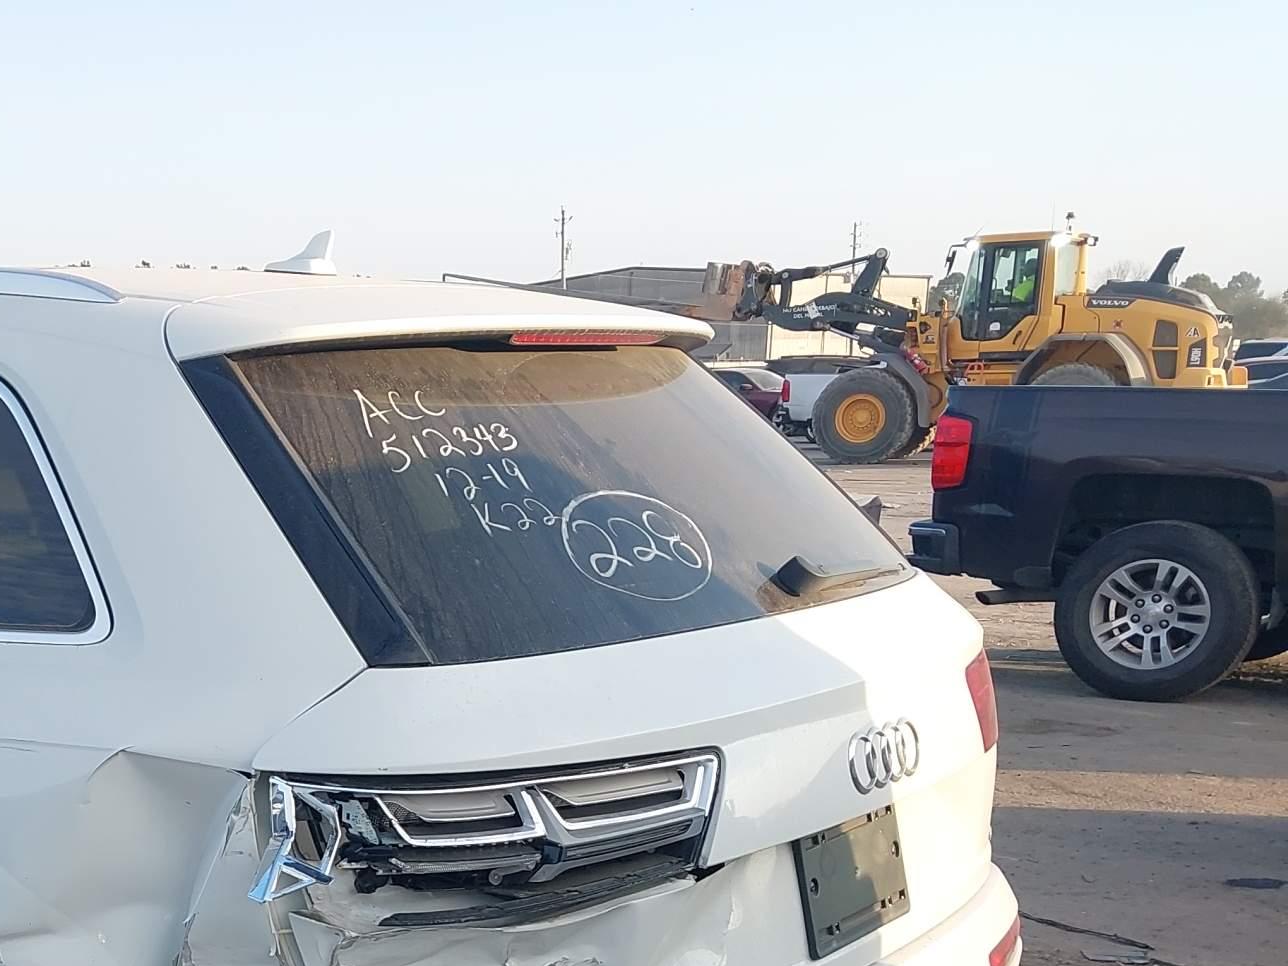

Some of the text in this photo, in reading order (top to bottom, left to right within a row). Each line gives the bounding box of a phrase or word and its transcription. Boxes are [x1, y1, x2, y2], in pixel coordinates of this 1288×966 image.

[352, 388, 446, 438] ACC
[381, 421, 519, 473] 512343
[434, 457, 533, 501] 12-19
[470, 498, 562, 537] K22
[572, 510, 703, 578] 228
